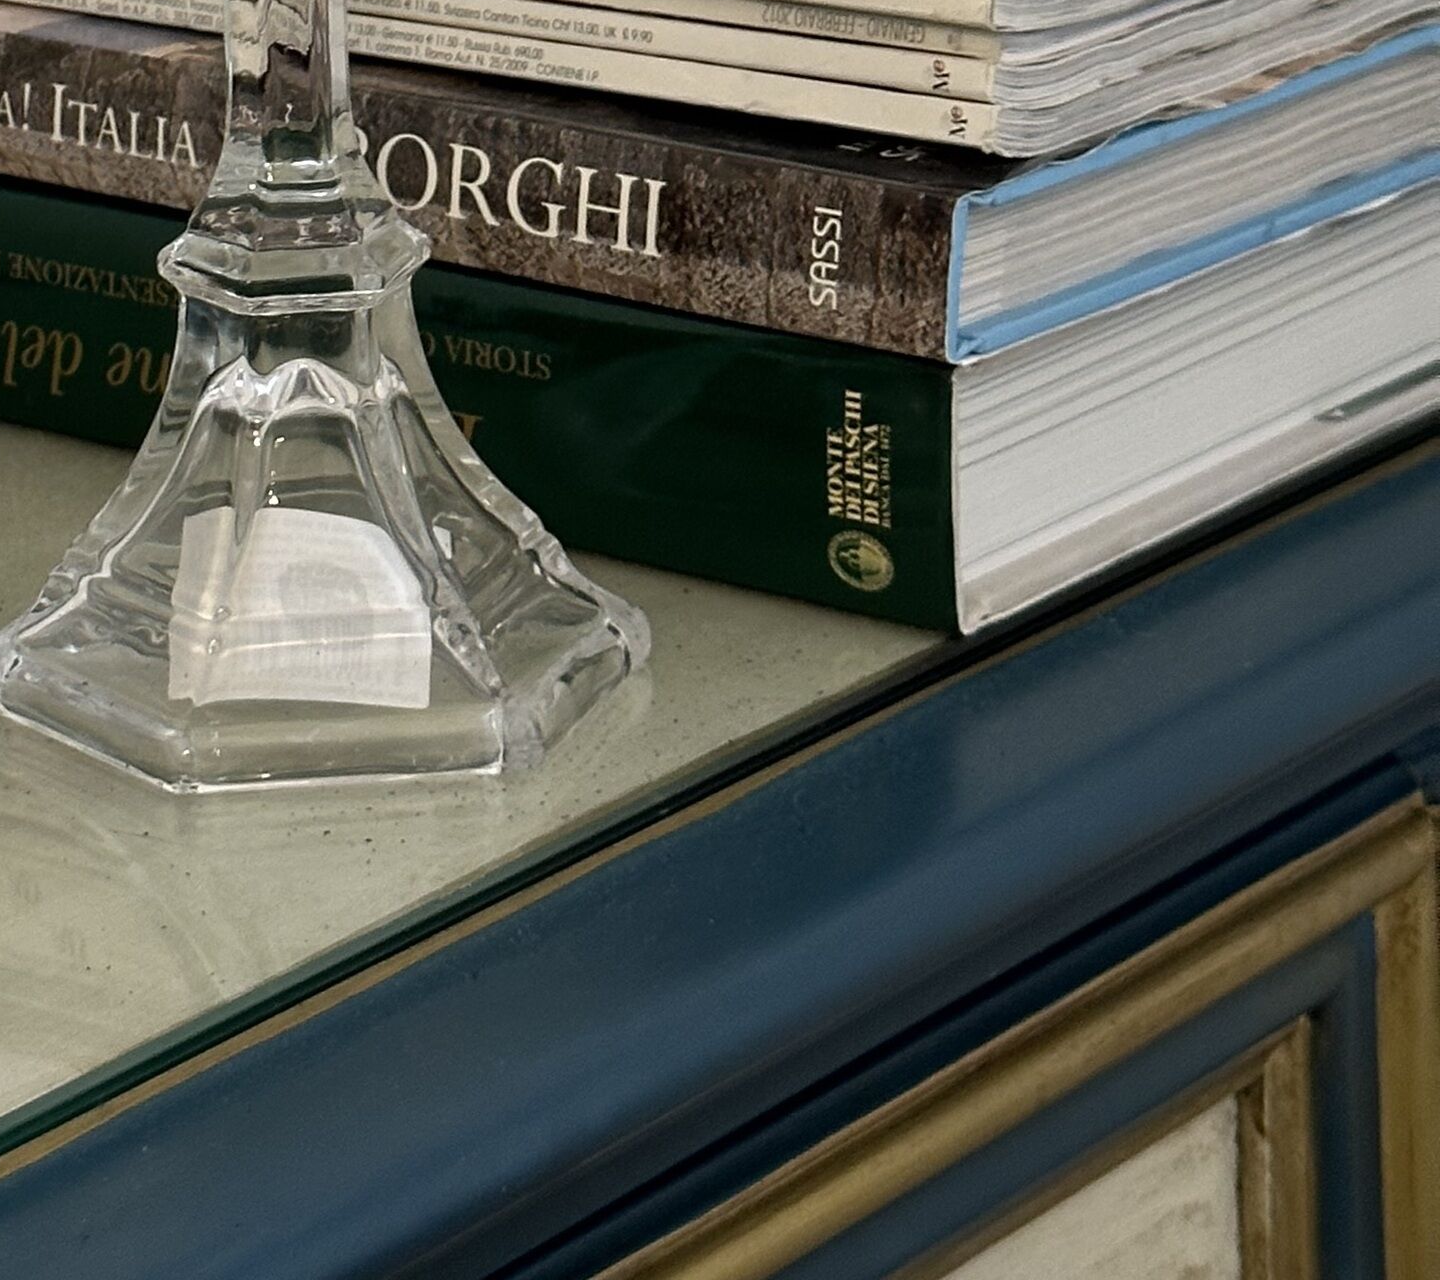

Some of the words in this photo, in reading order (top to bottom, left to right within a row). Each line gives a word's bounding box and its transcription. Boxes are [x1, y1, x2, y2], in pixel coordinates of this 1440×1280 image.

[761, 1, 795, 24] 2012
[51, 82, 202, 169] ITALIA
[356, 126, 668, 258] ORGHI
[8, 251, 178, 308] SENTAZIONE
[809, 206, 843, 310] SASSI
[0, 319, 84, 396] del
[444, 330, 553, 382] STORIA
[844, 389, 862, 477] PASCHI
[862, 423, 879, 495] SIENA
[826, 426, 844, 517] MONTE
[845, 477, 862, 522] DEI
[862, 498, 880, 526] DI
